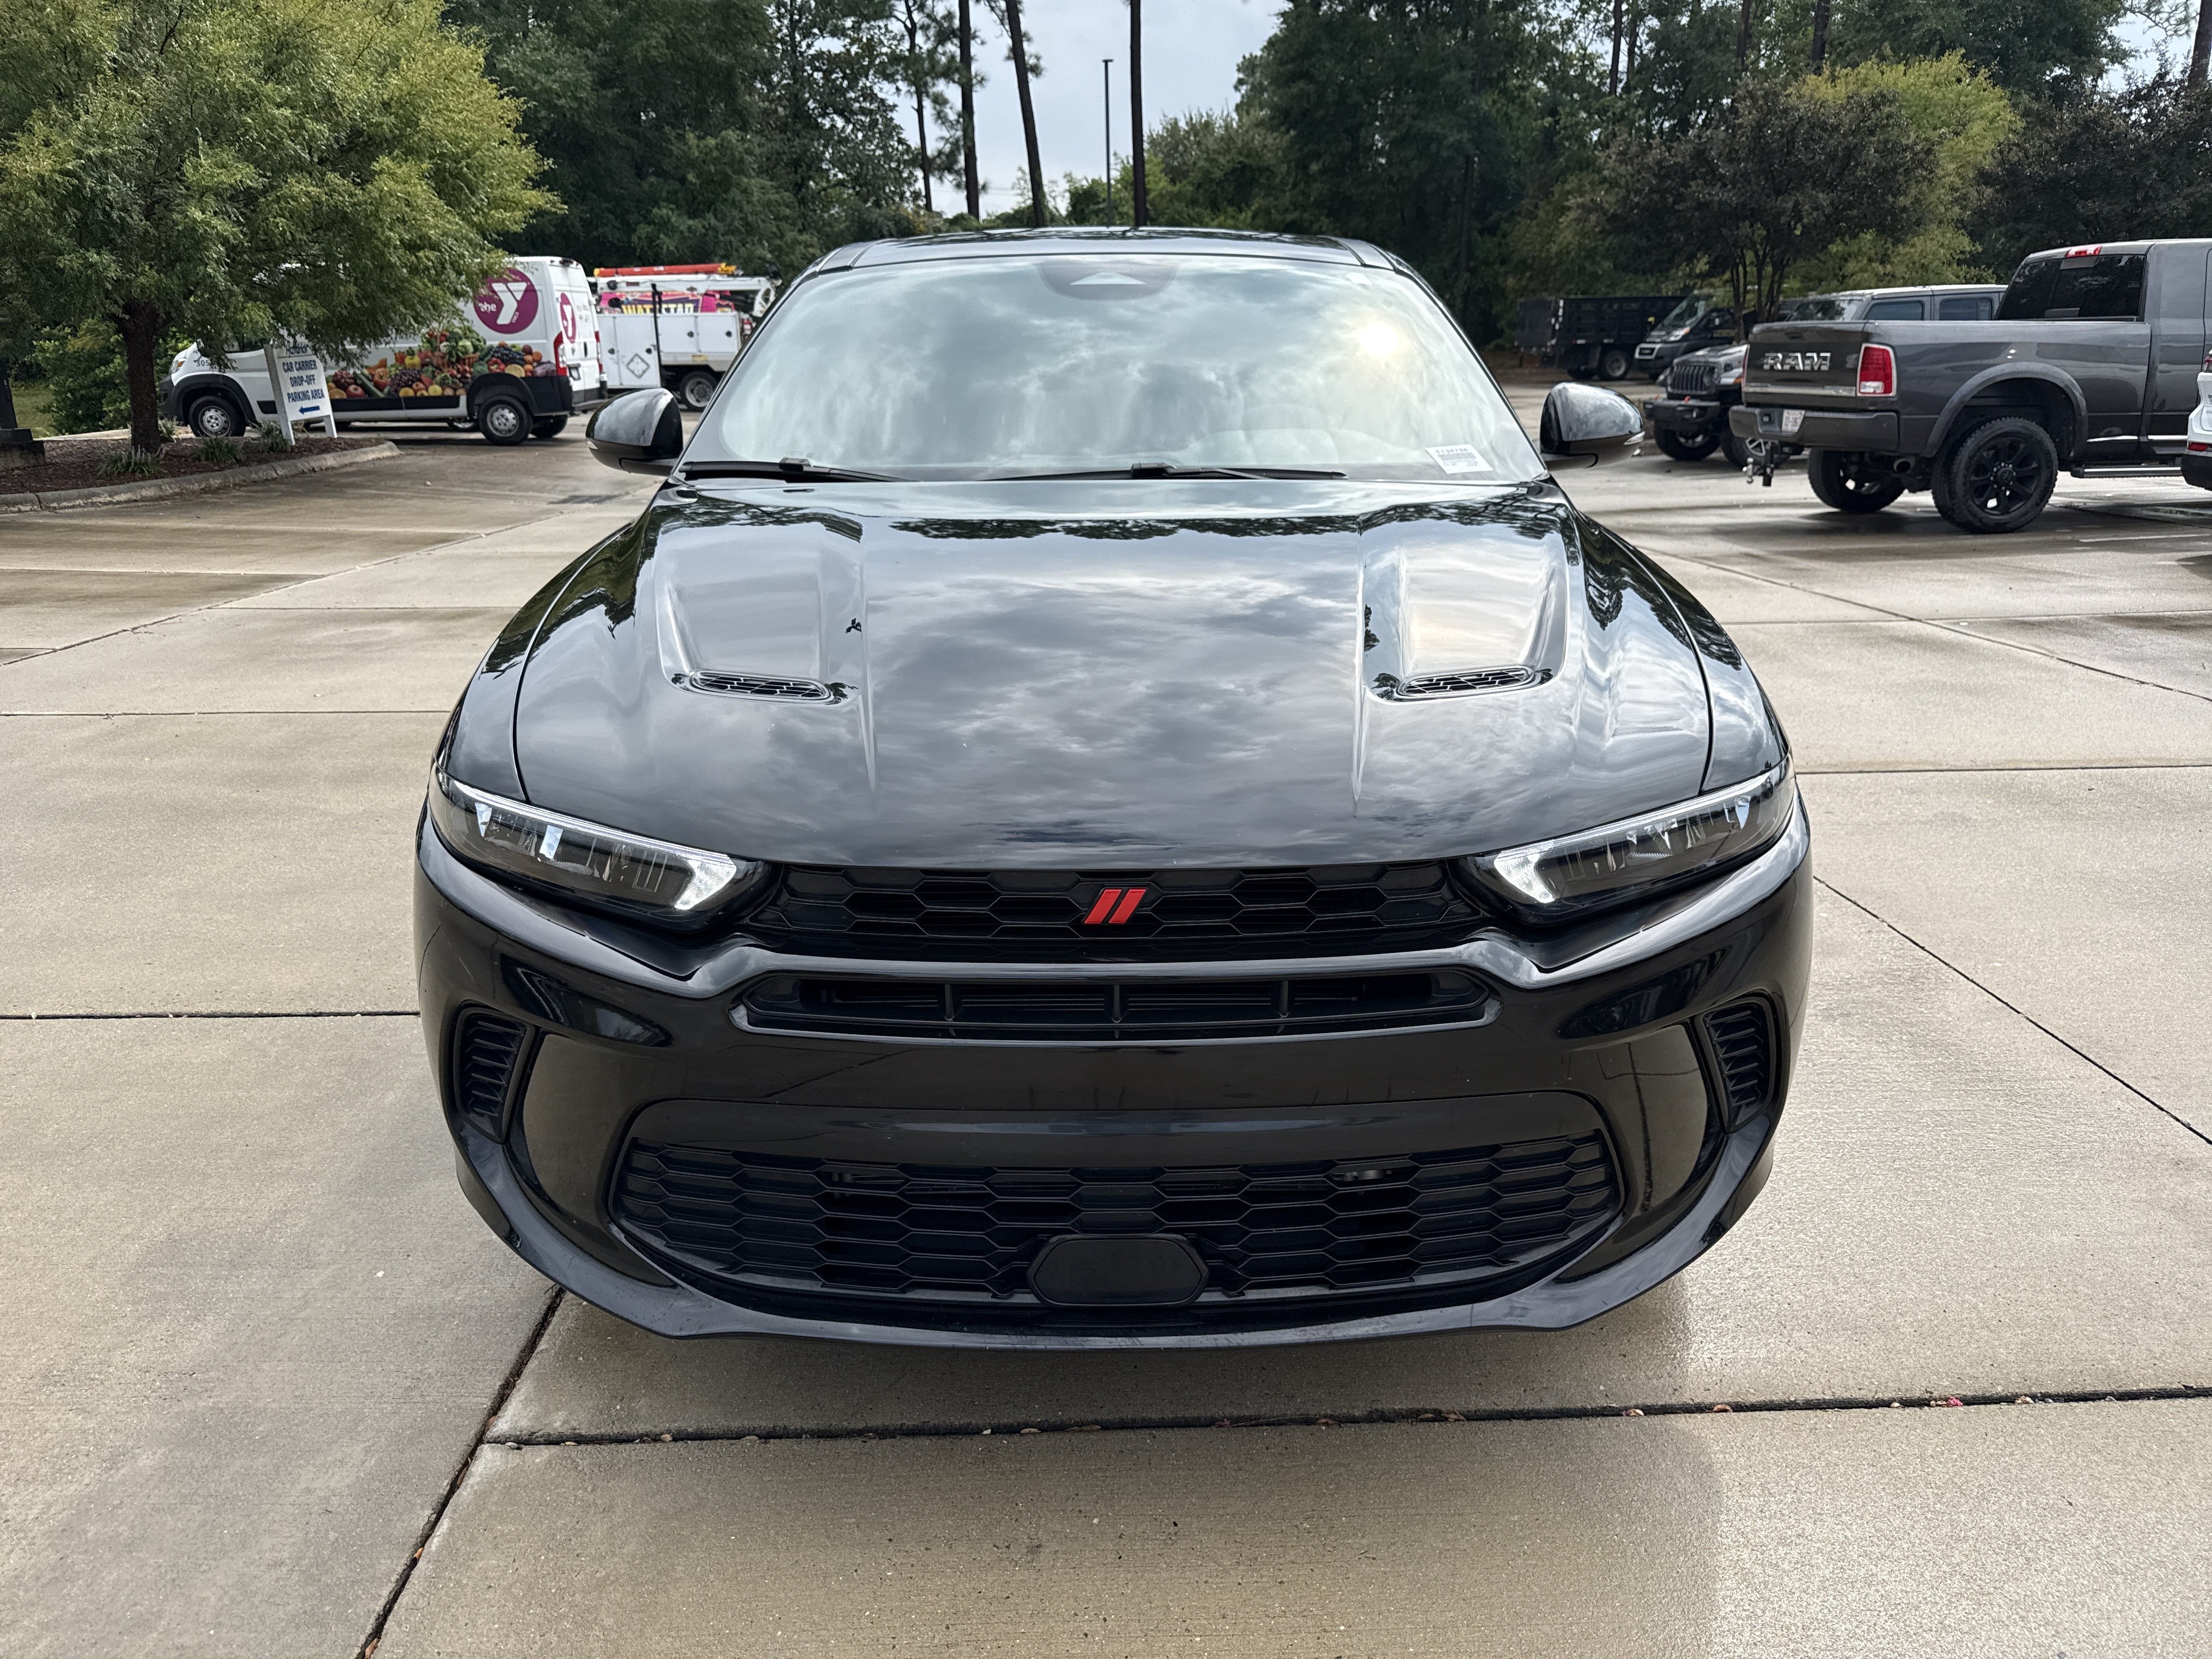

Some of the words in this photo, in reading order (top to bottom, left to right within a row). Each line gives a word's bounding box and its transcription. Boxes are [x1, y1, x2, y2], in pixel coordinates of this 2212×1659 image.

[282, 362, 295, 373] CAR
[294, 359, 318, 371] CARRIER
[1763, 352, 1831, 371] RAM
[290, 374, 315, 387] DROP-OFF
[287, 390, 311, 403] PARKING
[311, 388, 325, 399] AREA
